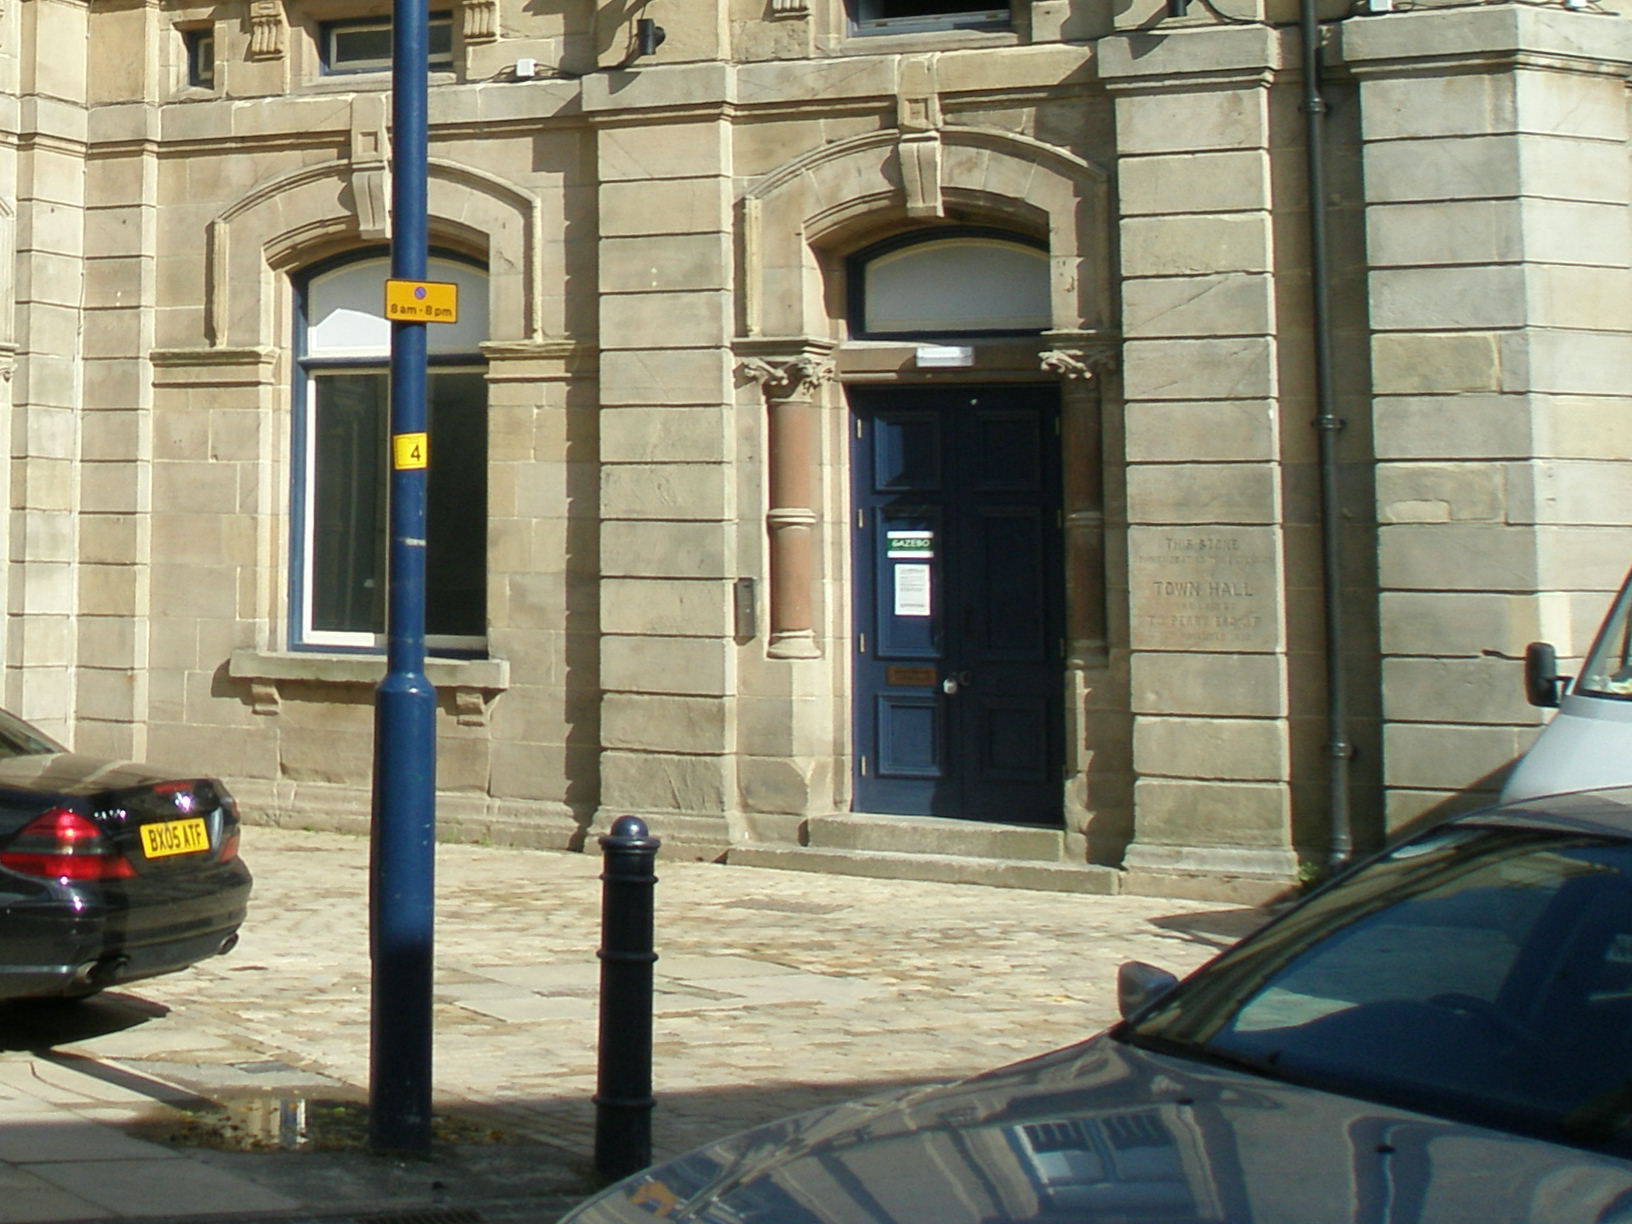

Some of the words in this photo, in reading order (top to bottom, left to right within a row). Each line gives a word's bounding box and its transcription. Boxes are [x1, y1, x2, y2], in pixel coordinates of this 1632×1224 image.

[410, 443, 421, 462] 4
[891, 539, 930, 547] GAZEBO
[1152, 580, 1201, 597] TOWN
[1208, 580, 1254, 597] HALL
[148, 825, 181, 852] BX05
[182, 823, 201, 848] ATF
